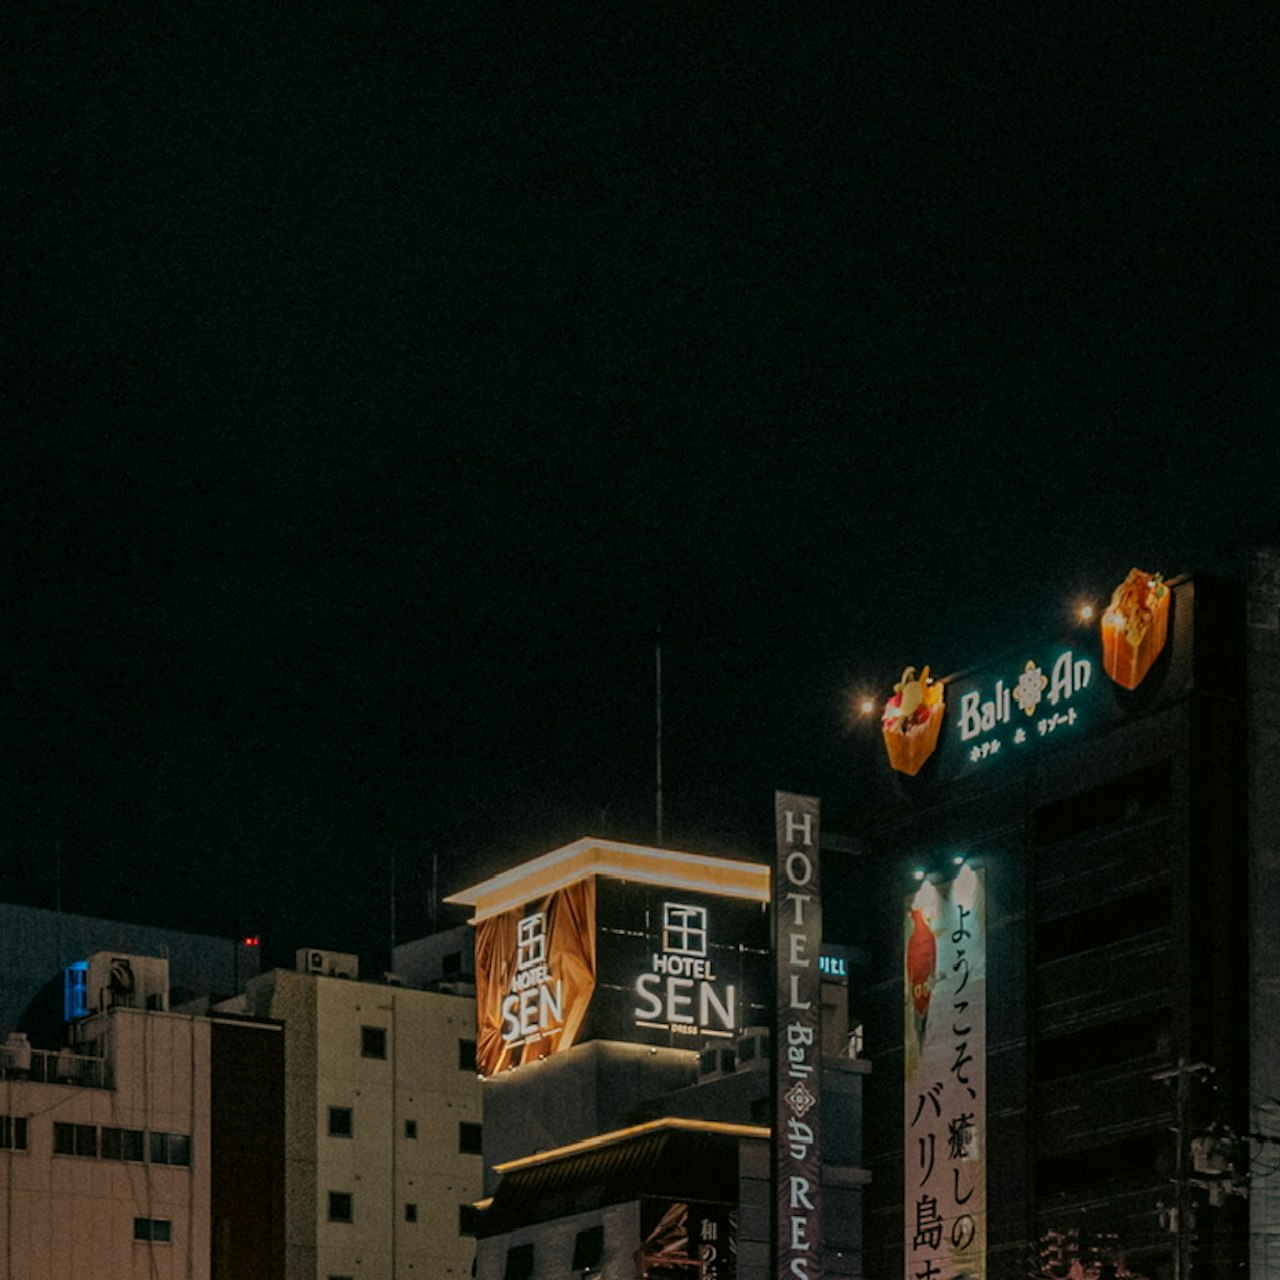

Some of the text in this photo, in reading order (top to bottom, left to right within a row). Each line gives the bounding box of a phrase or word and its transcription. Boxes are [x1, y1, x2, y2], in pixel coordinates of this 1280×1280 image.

[957, 650, 1092, 742] Bali An
[785, 810, 814, 1011] HOTEL
[513, 966, 552, 993] HOTEL
[652, 953, 717, 981] HOTEL
[502, 978, 563, 1042] SEN
[634, 972, 735, 1029] SEN
